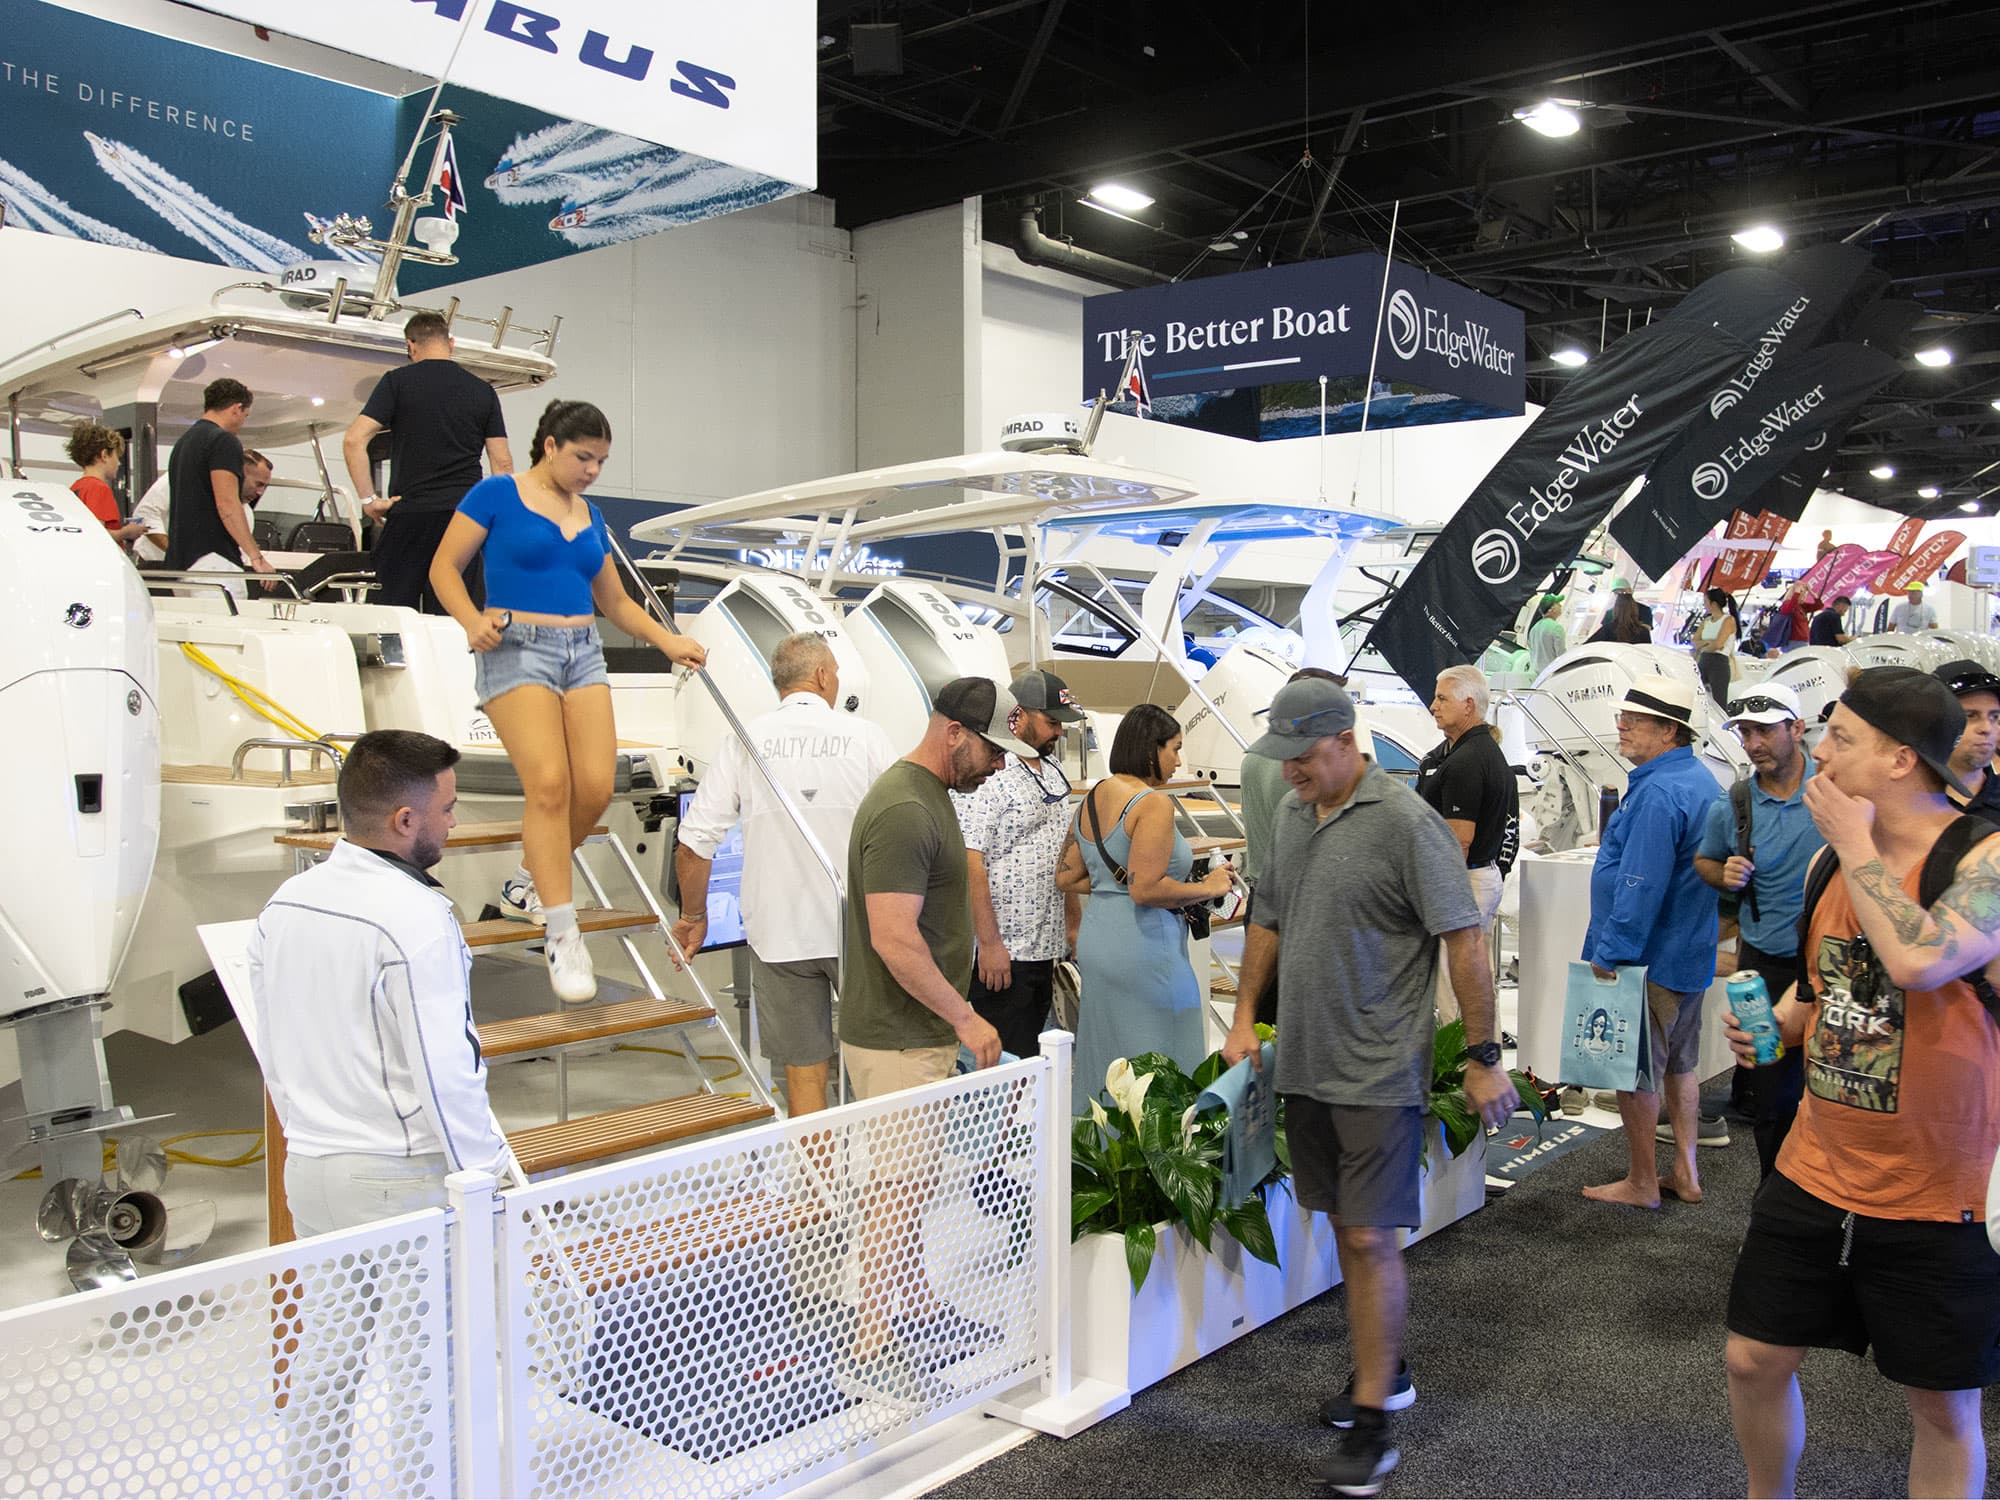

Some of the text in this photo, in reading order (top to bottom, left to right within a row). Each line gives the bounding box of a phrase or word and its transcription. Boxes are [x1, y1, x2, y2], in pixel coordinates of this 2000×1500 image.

[2, 62, 253, 142] THE DIFFERENCE
[283, 267, 317, 285] RAD
[1097, 304, 1350, 362] The Better Boat
[1423, 307, 1515, 376] EdgeWater
[1001, 421, 1043, 437] MRAD
[1719, 384, 1826, 473] EdgeWater
[1505, 393, 1643, 541] EdgeWater
[952, 632, 974, 641] V8
[1566, 684, 1615, 703] YAMAHA
[762, 735, 852, 760] SALTY LADY
[1499, 813, 1518, 865] HMY
[1498, 1125, 1587, 1174] NIMBUS
